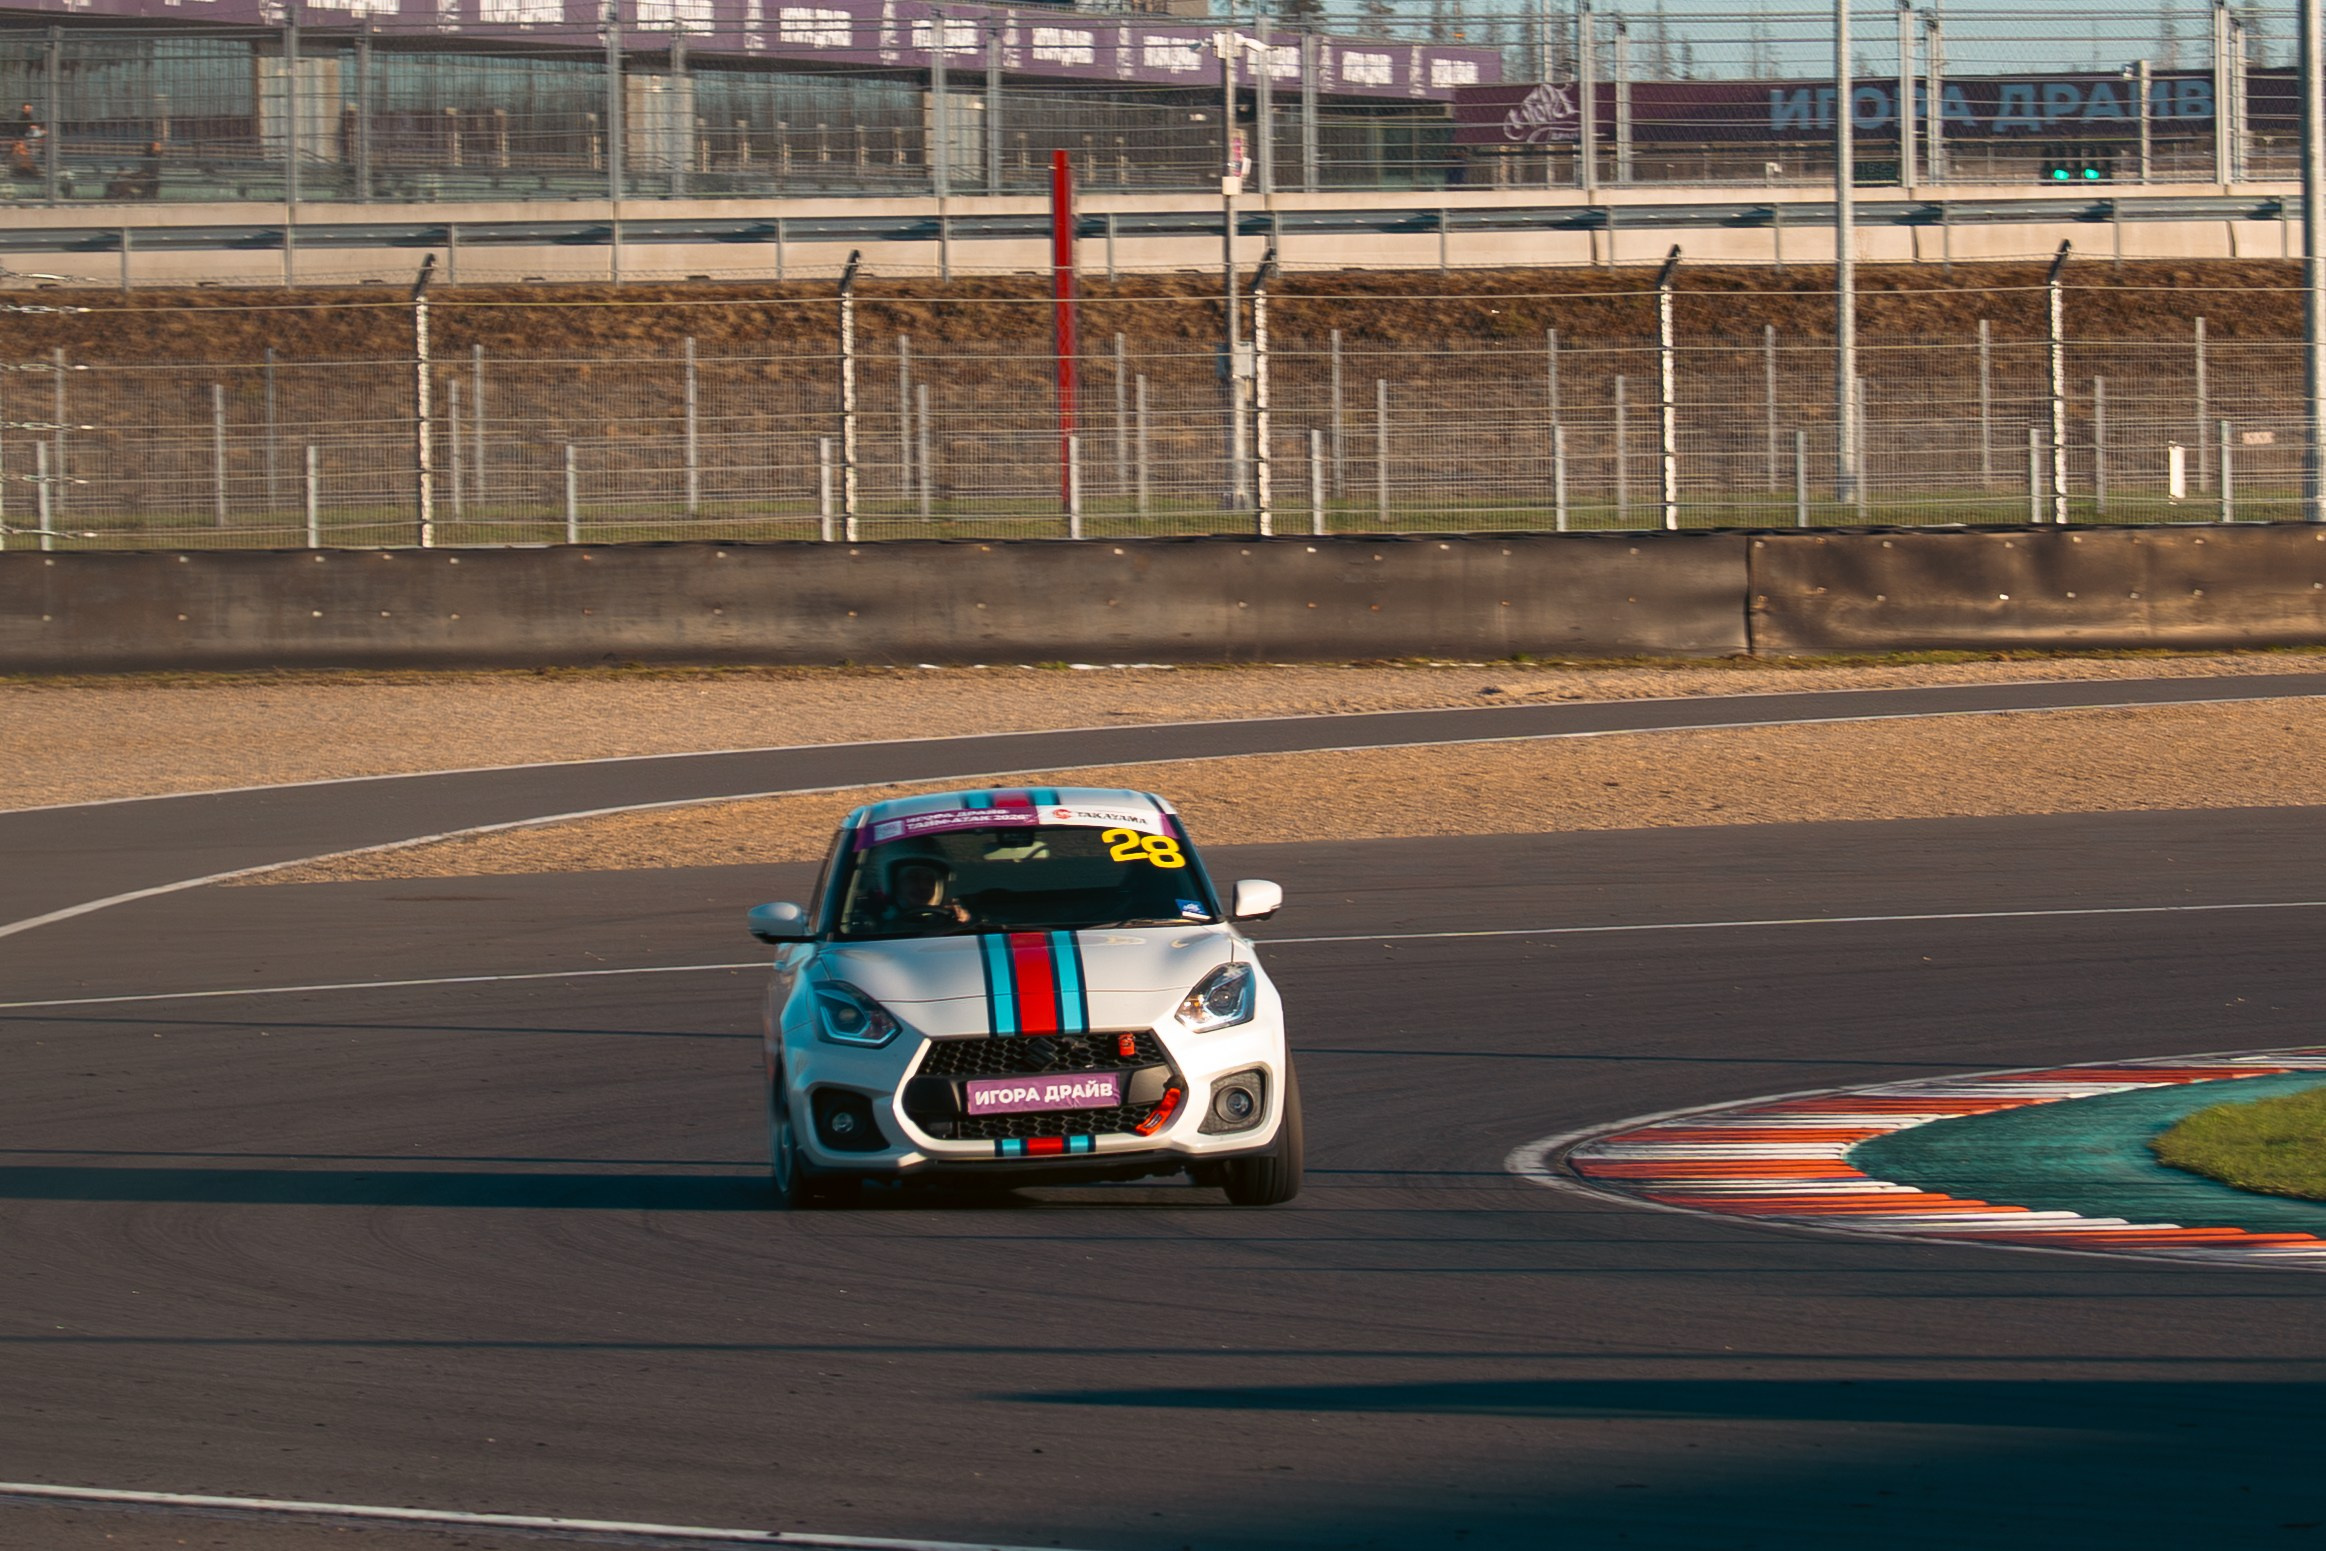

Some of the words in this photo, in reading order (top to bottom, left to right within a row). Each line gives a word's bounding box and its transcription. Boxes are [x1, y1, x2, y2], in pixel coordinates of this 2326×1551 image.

[1769, 84, 1978, 131] ИГОРА
[1076, 811, 1148, 825] TAKAYAMA
[1101, 828, 1187, 869] 28
[974, 1087, 1041, 1106] ИГОРА
[1044, 1080, 1114, 1103] ДРАЙВ
